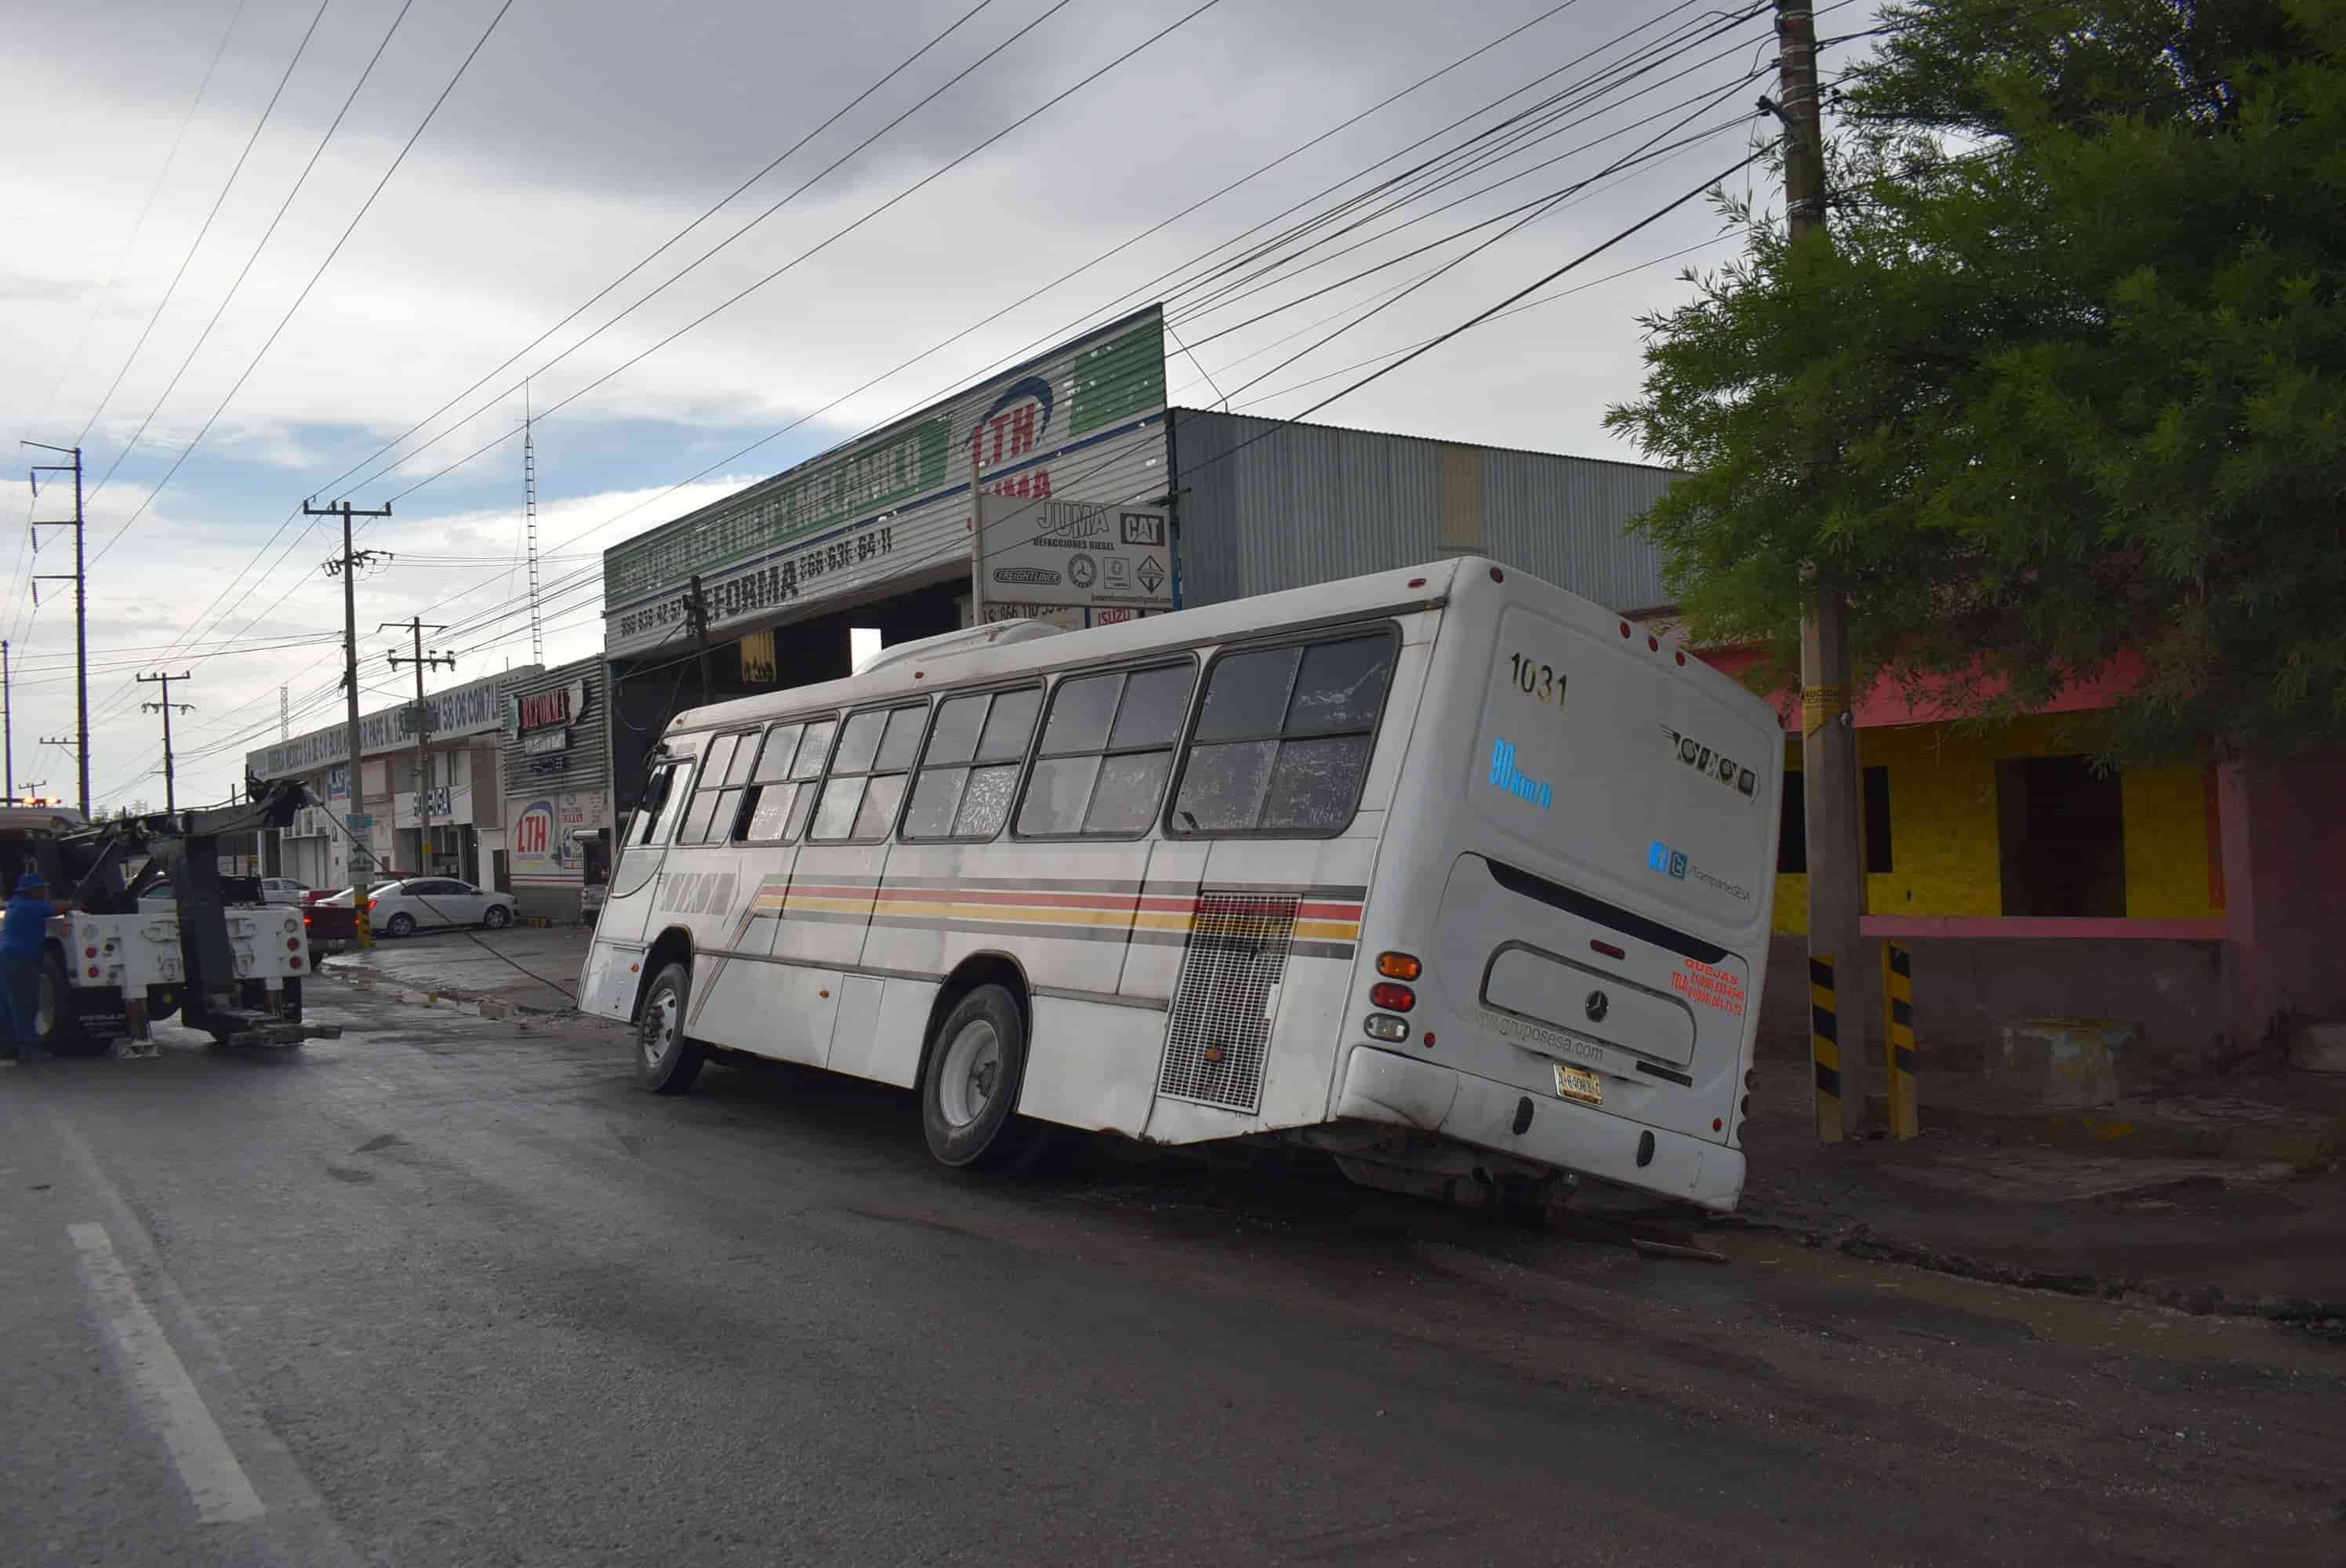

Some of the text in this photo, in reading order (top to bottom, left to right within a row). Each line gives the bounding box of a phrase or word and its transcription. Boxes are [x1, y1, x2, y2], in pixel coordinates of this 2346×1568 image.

[1037, 502, 1109, 539] JUMA
[1125, 516, 1160, 543] CAT
[1089, 541, 1115, 551] DIESEL
[997, 571, 1059, 583] FREIGHTLINER
[1098, 608, 1130, 626] ISUZU
[1511, 652, 1568, 712] 1031
[468, 684, 485, 724] CON
[521, 690, 566, 728] REFORMA
[518, 815, 547, 853] LTH
[1685, 958, 1738, 985] QUEJAS
